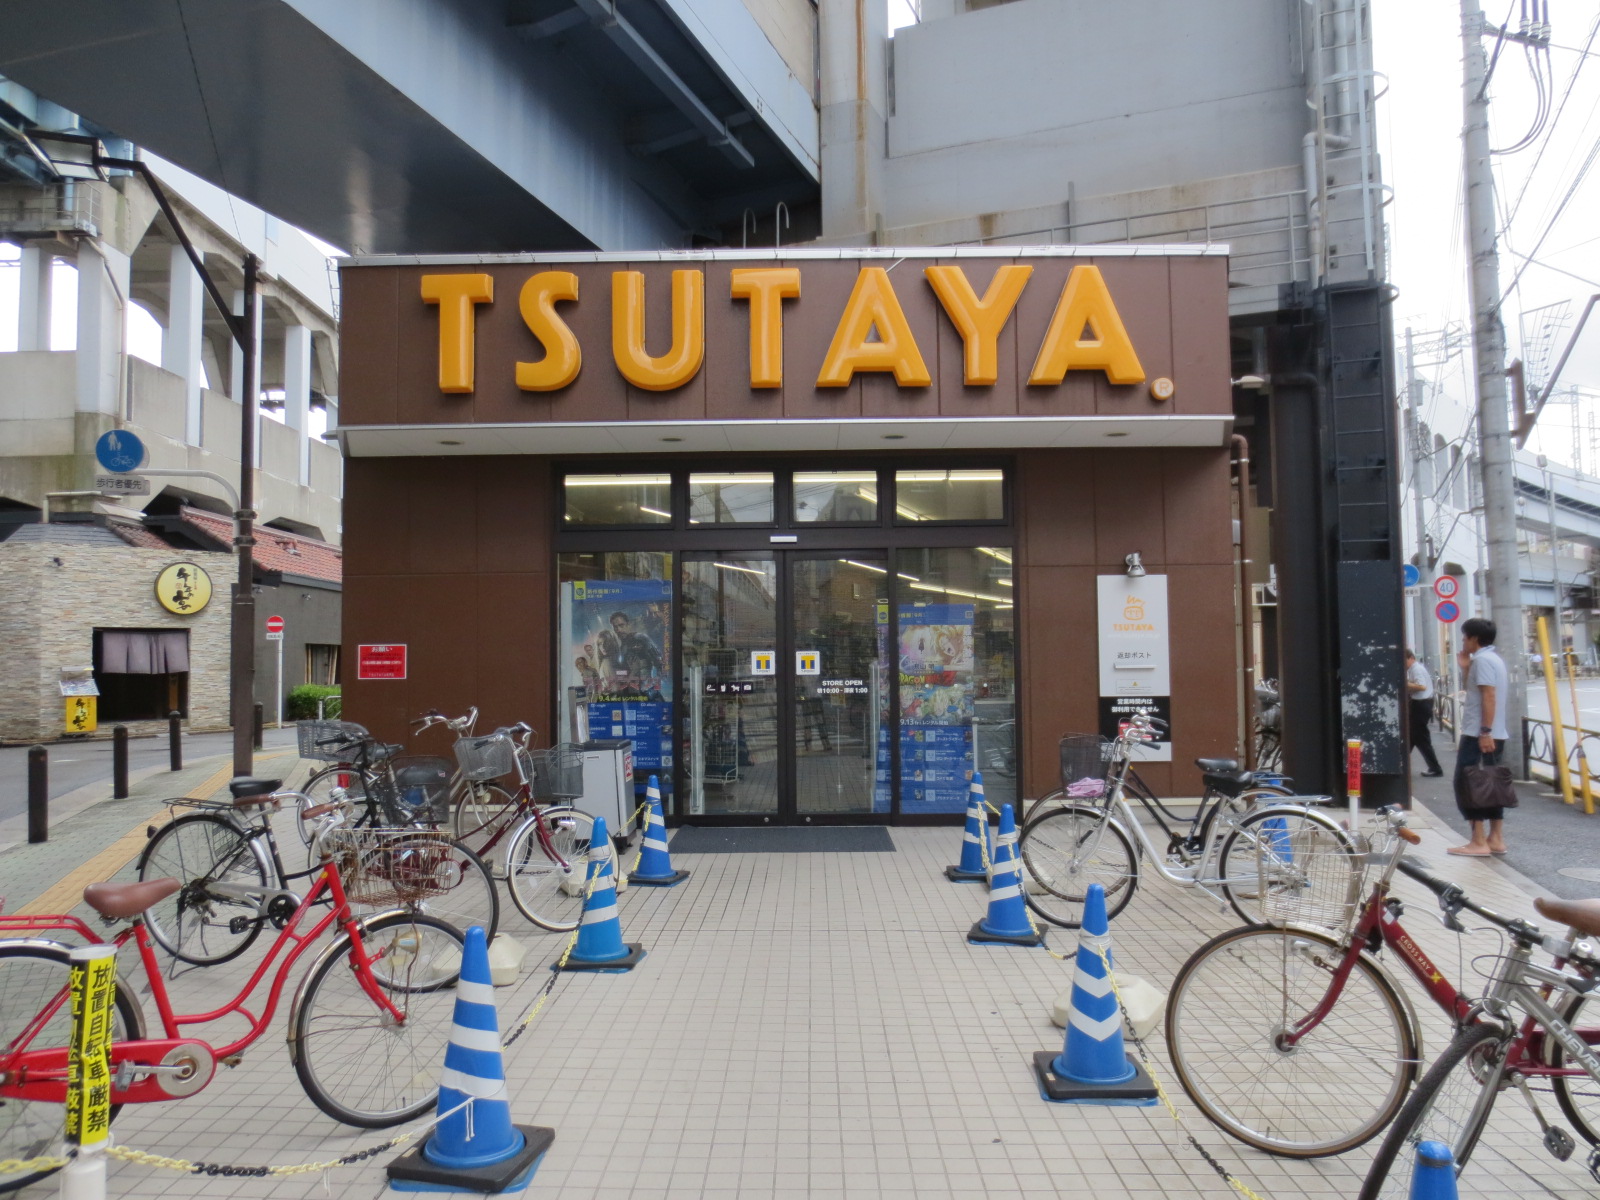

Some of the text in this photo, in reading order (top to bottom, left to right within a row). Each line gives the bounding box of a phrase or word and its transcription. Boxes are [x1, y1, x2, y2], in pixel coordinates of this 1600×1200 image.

[420, 264, 1146, 394] TSUTAYA
[96, 478, 142, 490] 歩行者優先
[1439, 582, 1453, 593] 40
[1400, 935, 1419, 957] CROSS
[1417, 956, 1431, 970] WAY
[85, 964, 111, 1133] 放置自転車厳禁
[1550, 1019, 1600, 1077] CHEVR
